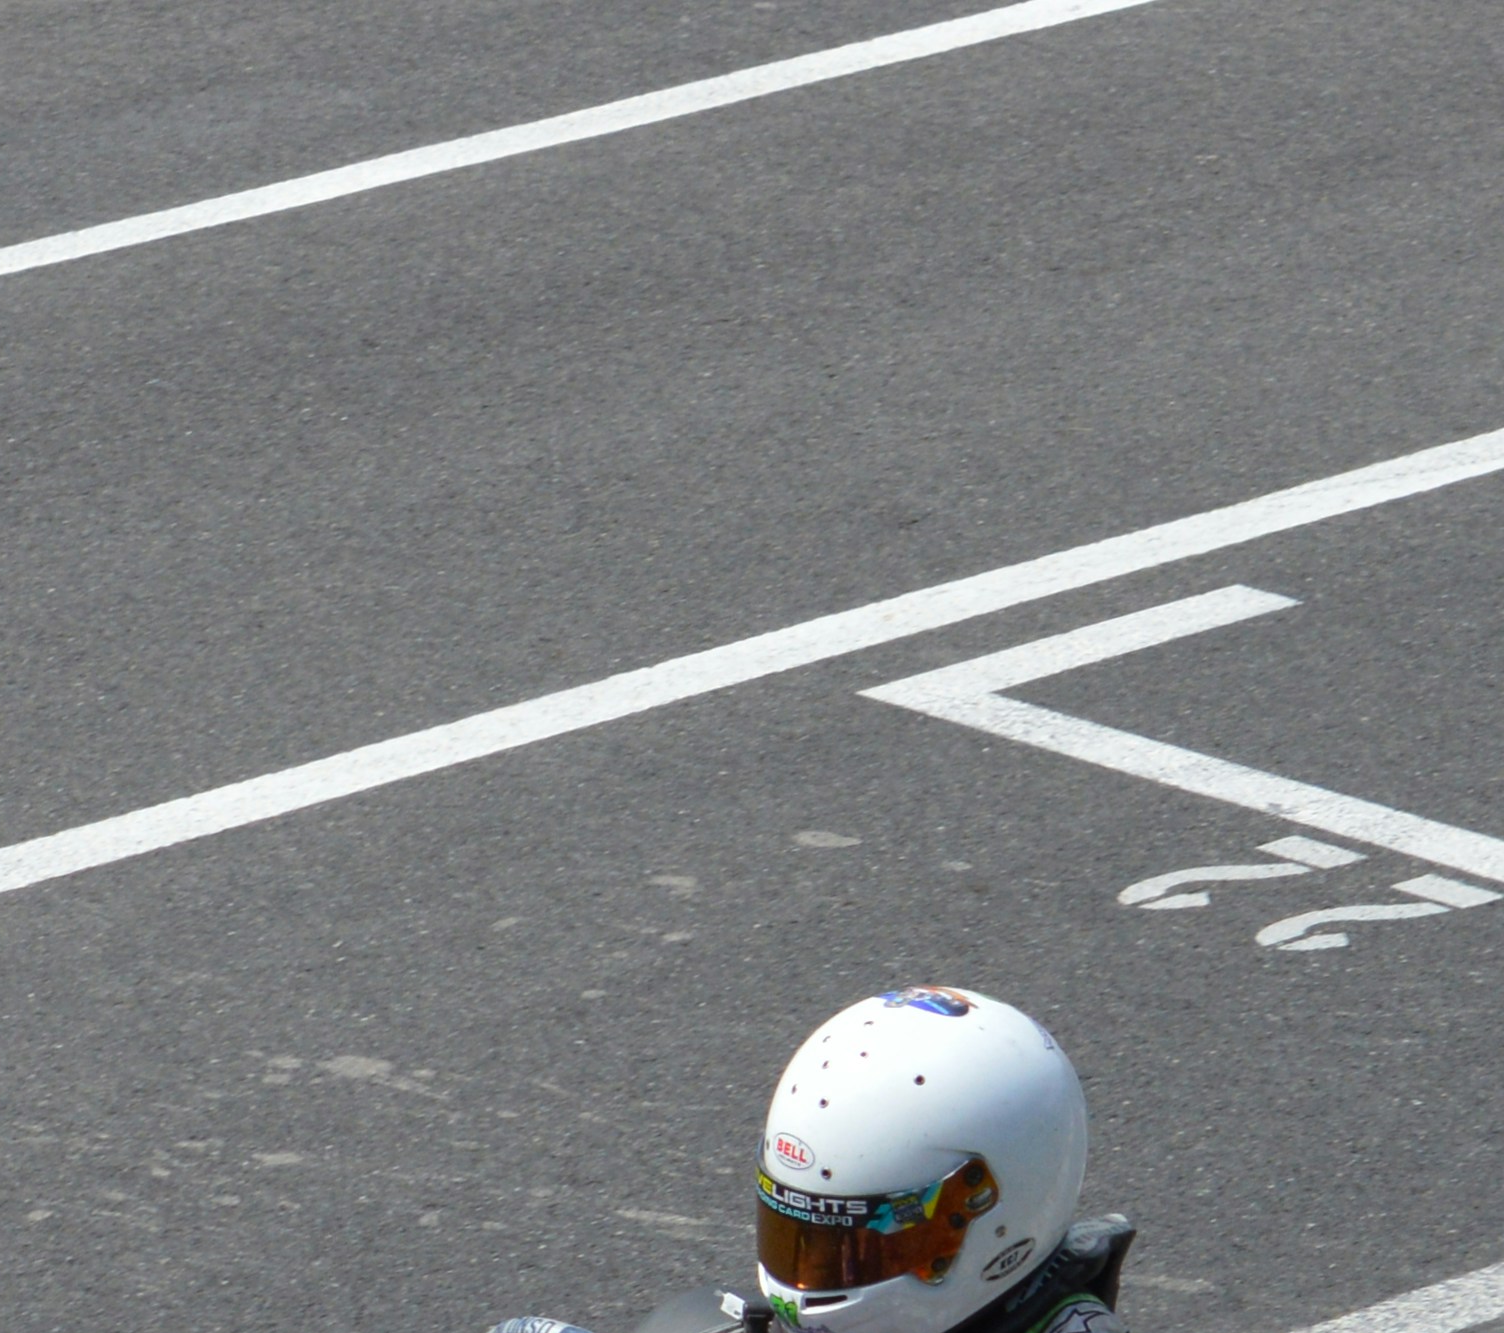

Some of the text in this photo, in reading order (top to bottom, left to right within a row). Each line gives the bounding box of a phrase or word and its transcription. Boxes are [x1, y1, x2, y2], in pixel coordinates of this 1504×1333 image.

[1117, 834, 1504, 951] 22
[777, 1138, 808, 1164] BELL
[778, 1203, 811, 1221] CARD
[811, 1212, 853, 1227] EXPO
